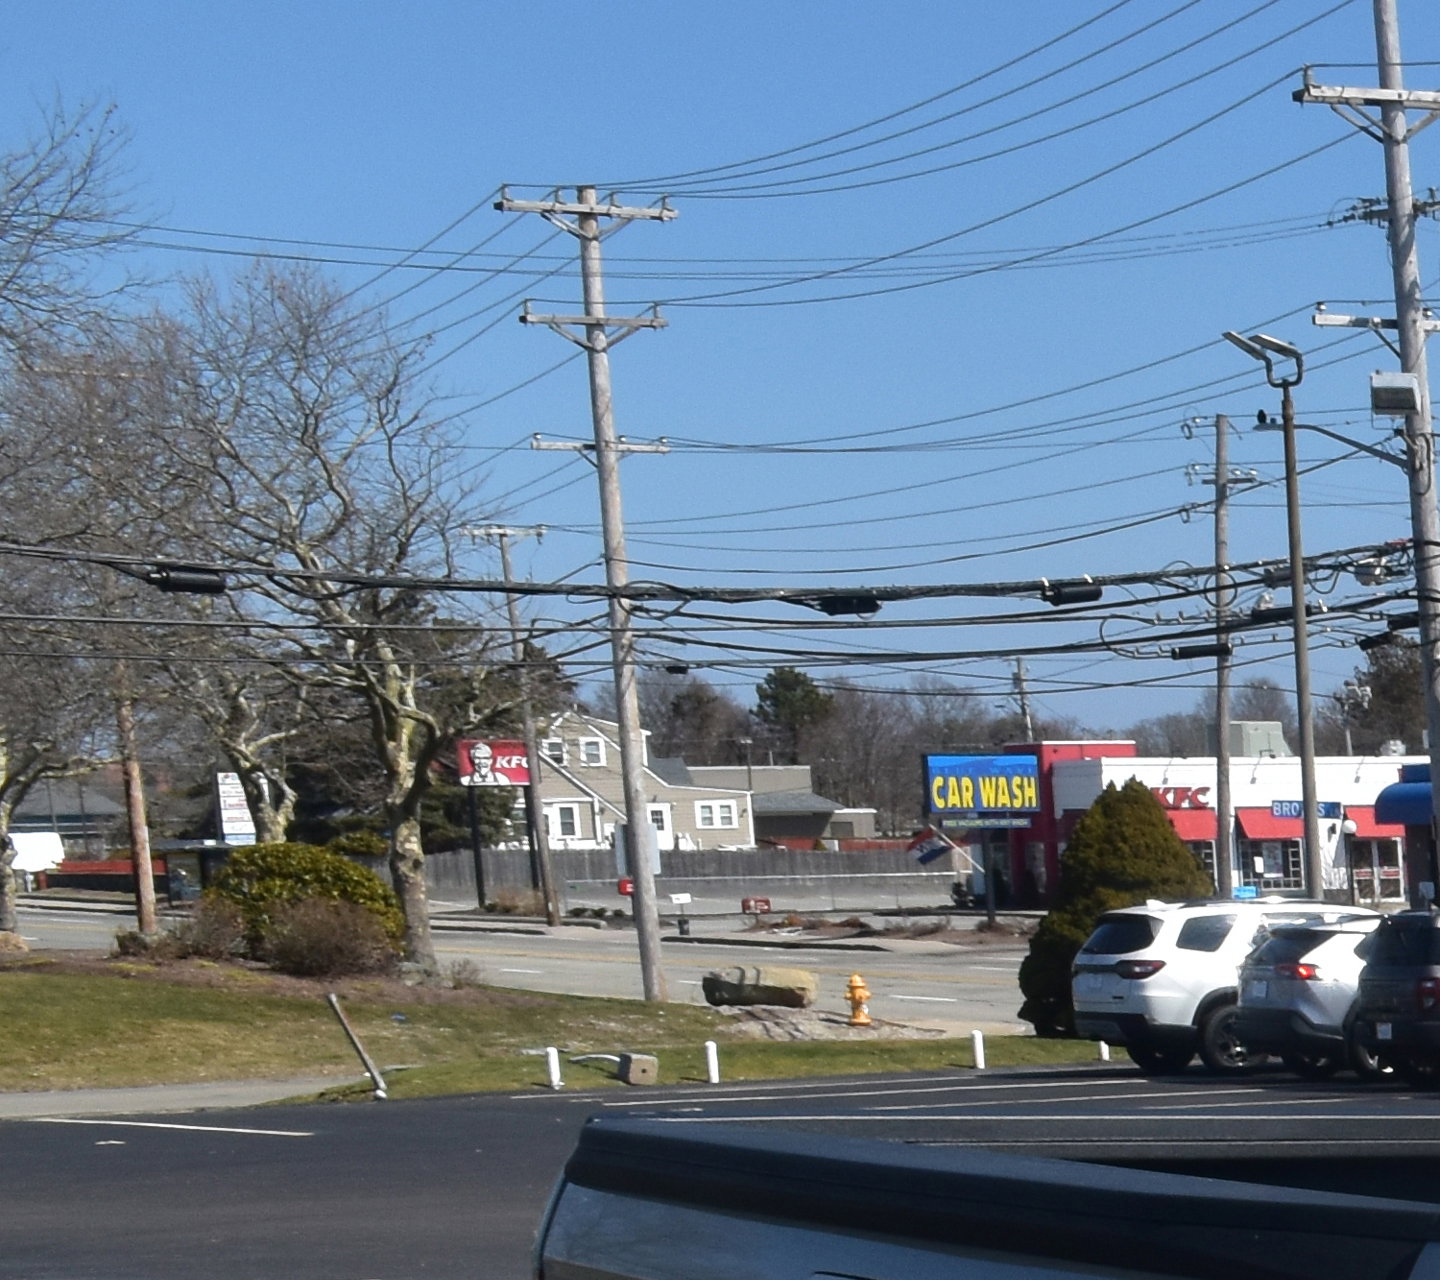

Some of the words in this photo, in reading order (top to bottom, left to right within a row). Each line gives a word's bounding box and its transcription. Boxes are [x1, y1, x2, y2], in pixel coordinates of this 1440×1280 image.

[932, 776, 974, 808] CAR
[979, 776, 1037, 808] WASH
[1150, 786, 1211, 809] KFC
[1273, 802, 1325, 816] BROS
